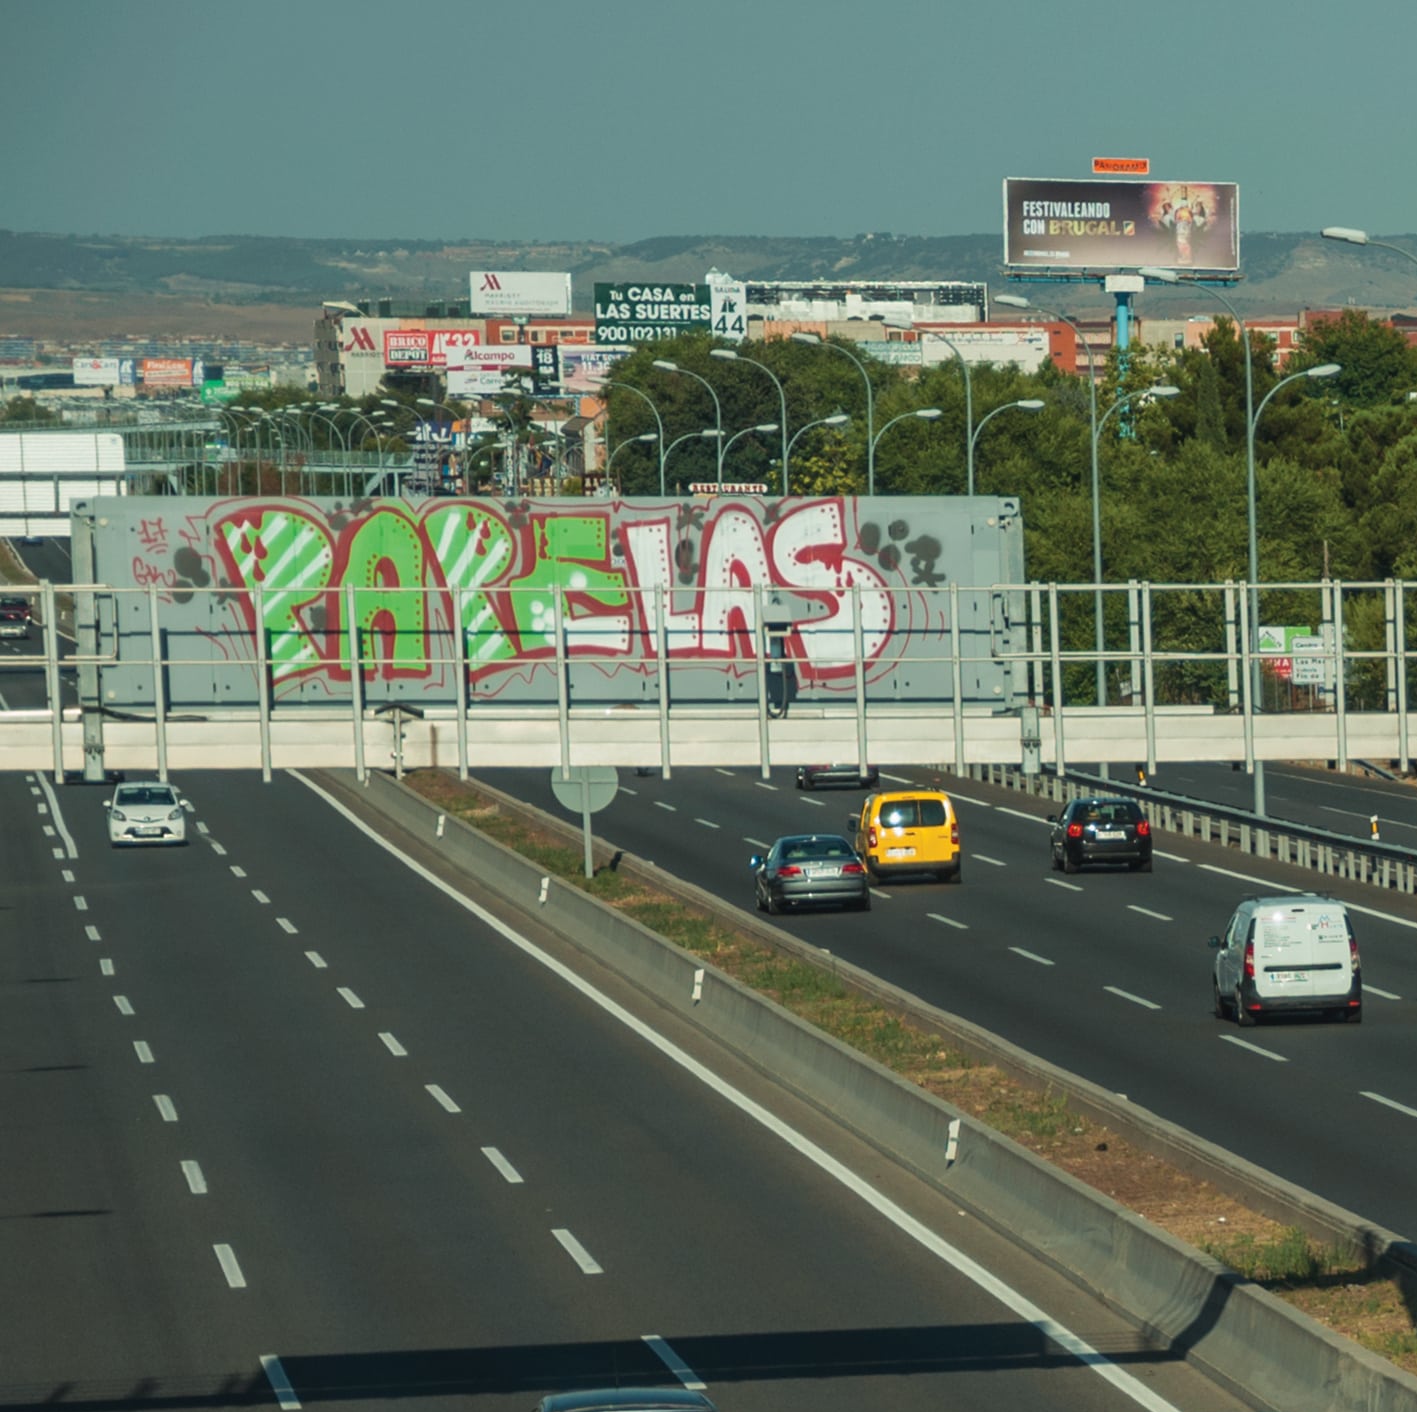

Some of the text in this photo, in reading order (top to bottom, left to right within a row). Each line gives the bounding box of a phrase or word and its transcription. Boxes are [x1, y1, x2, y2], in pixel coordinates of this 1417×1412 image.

[1023, 200, 1110, 218] FESTIVALEANDO
[1023, 220, 1121, 236] CON BRUGAL
[609, 286, 696, 302] Tu CASA en
[595, 303, 711, 320] LAS SUERTES
[598, 326, 677, 341] 900 102 131
[390, 336, 426, 347] BRICO
[464, 348, 515, 362] Alcampo
[692, 484, 764, 493] RESTURANTE
